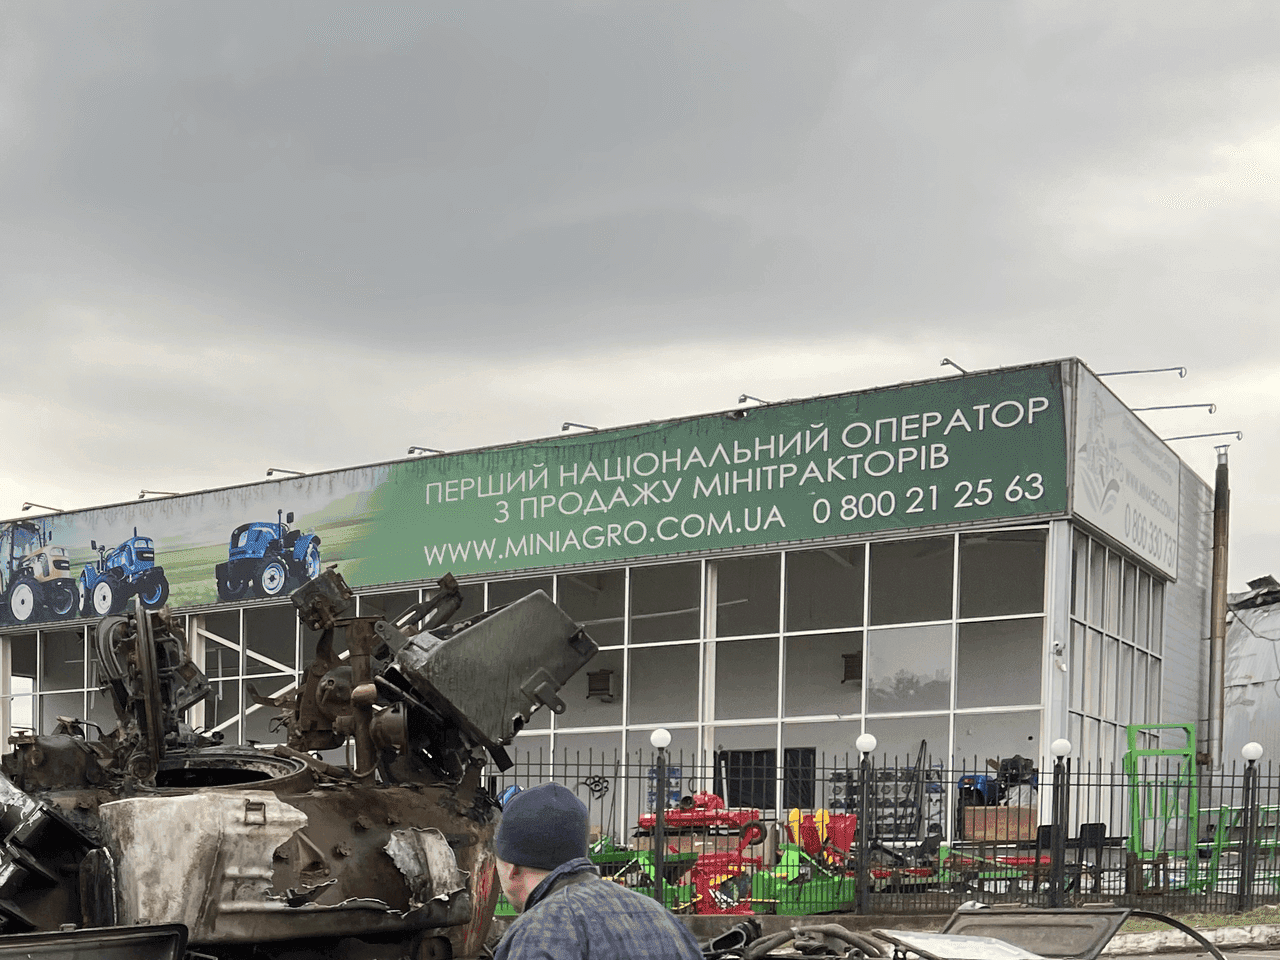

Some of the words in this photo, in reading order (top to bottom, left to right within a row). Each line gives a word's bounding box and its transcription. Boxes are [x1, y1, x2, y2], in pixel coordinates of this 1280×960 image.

[425, 462, 548, 505] ПЕРШИЙ
[560, 422, 829, 487] НАЦІОНАЛЬНИЙ
[841, 396, 1049, 449] ОПЕРАТОР
[520, 477, 682, 521] ПРОДАЖУ
[692, 443, 949, 499] МІНІТРАКТОРІВ
[423, 505, 786, 567] WWW.MINIAGRO.COM.UA
[812, 498, 832, 524] 0
[839, 490, 896, 521] 800
[905, 485, 938, 514] 21
[953, 478, 994, 508] 25
[1004, 472, 1045, 503] 63
[1132, 508, 1148, 550] 800
